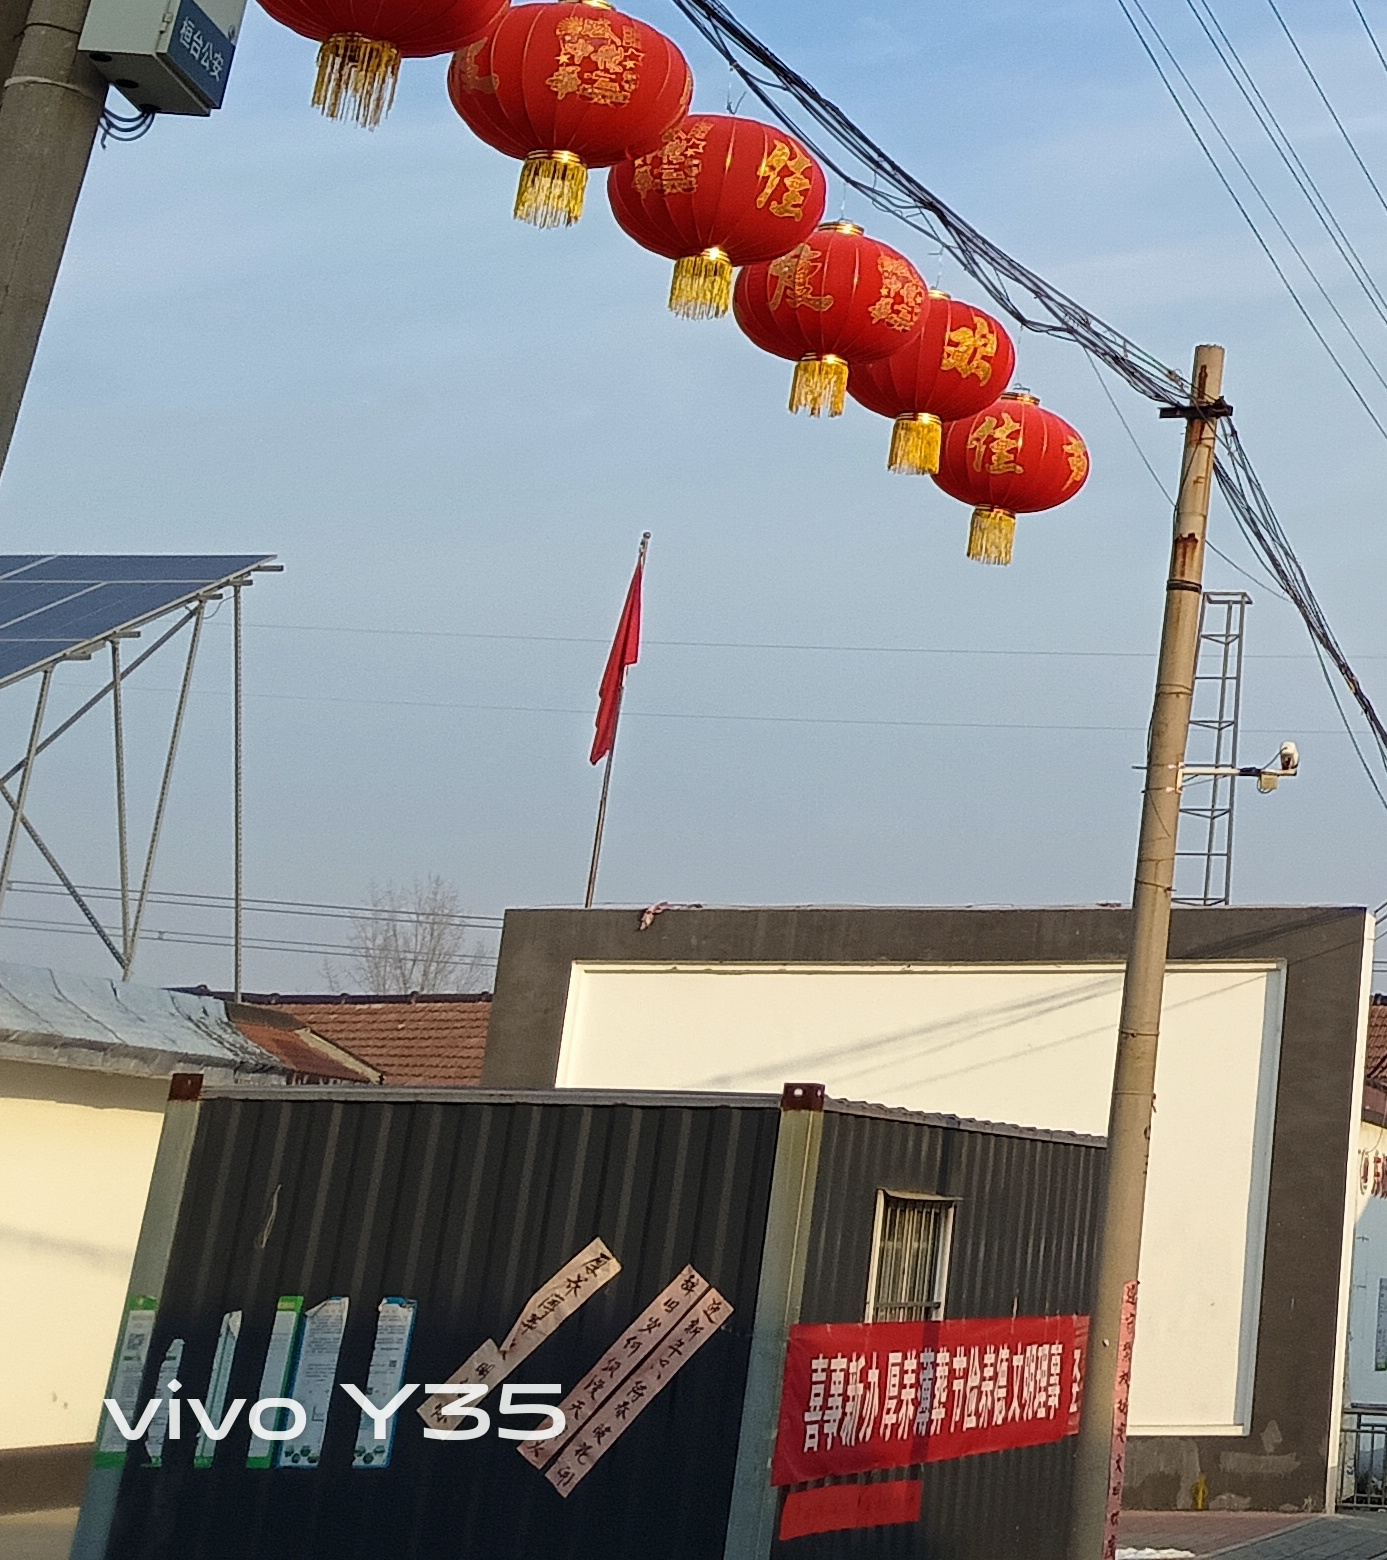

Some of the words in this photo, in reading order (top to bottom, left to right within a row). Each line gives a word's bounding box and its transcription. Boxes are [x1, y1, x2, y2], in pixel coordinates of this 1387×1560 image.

[179, 16, 224, 82] 桓台公安
[526, 1273, 700, 1458] 辞旧岁何须漫天火
